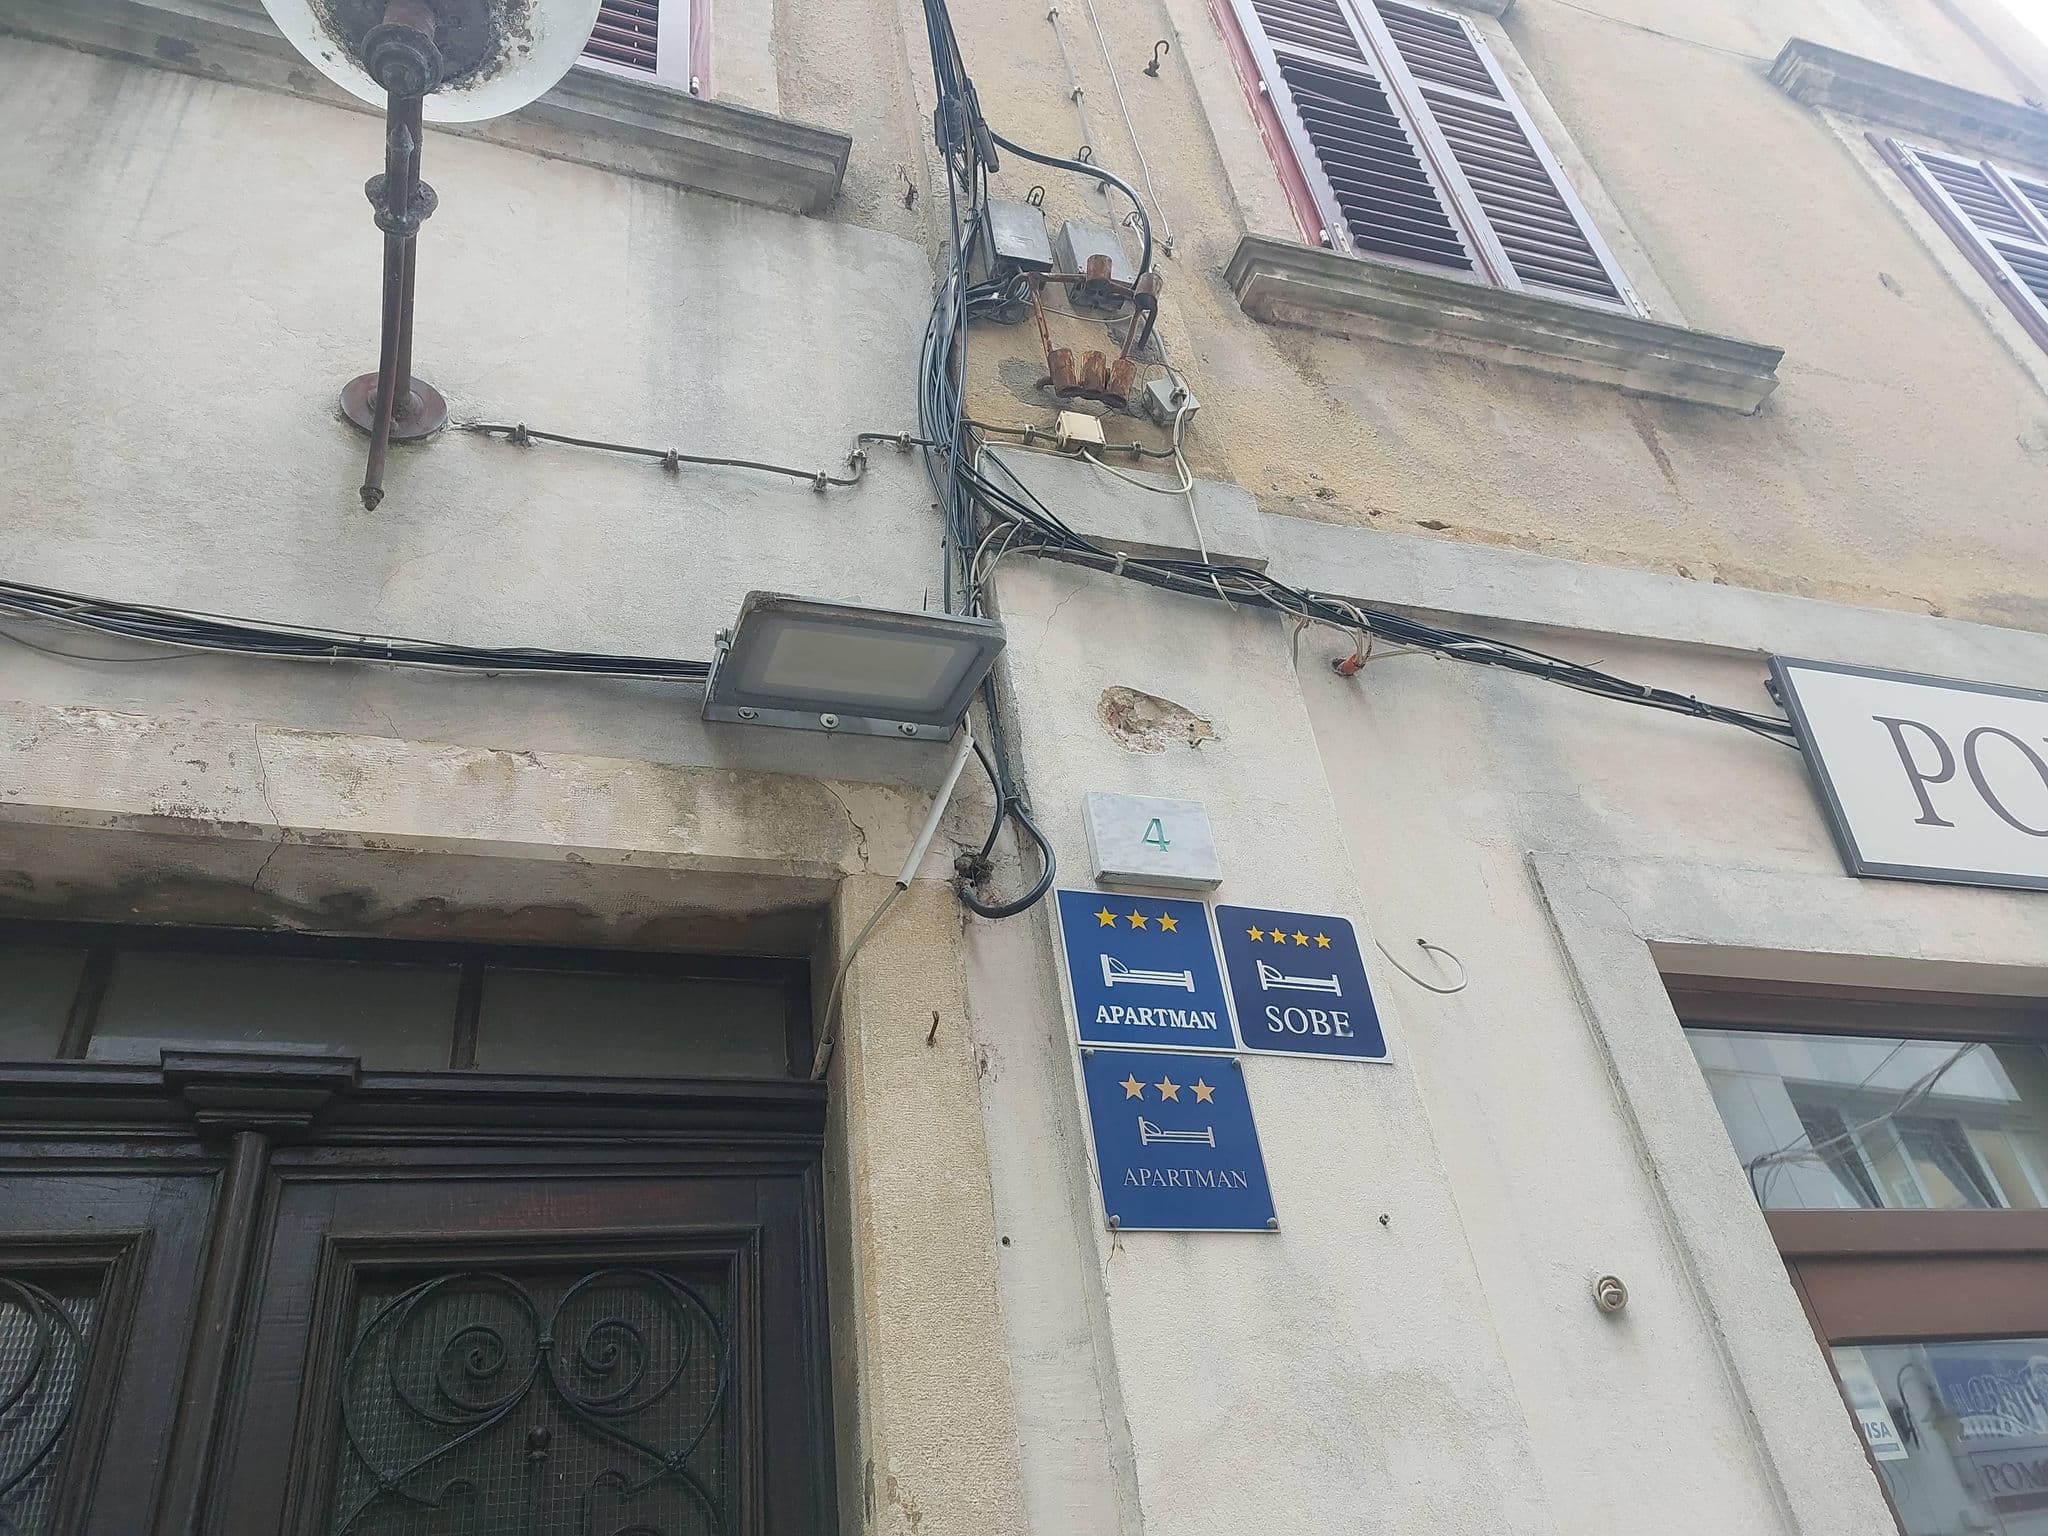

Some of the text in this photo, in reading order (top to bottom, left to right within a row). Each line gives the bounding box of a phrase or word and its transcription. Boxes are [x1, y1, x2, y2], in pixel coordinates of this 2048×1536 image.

[1871, 715, 2048, 837] PO
[1141, 818, 1170, 852] 4
[1096, 1005, 1217, 1030] APARTMAN
[1265, 1005, 1354, 1038] SOBE
[1123, 1168, 1248, 1188] APARTMAN
[1860, 1421, 1892, 1439] ISA
